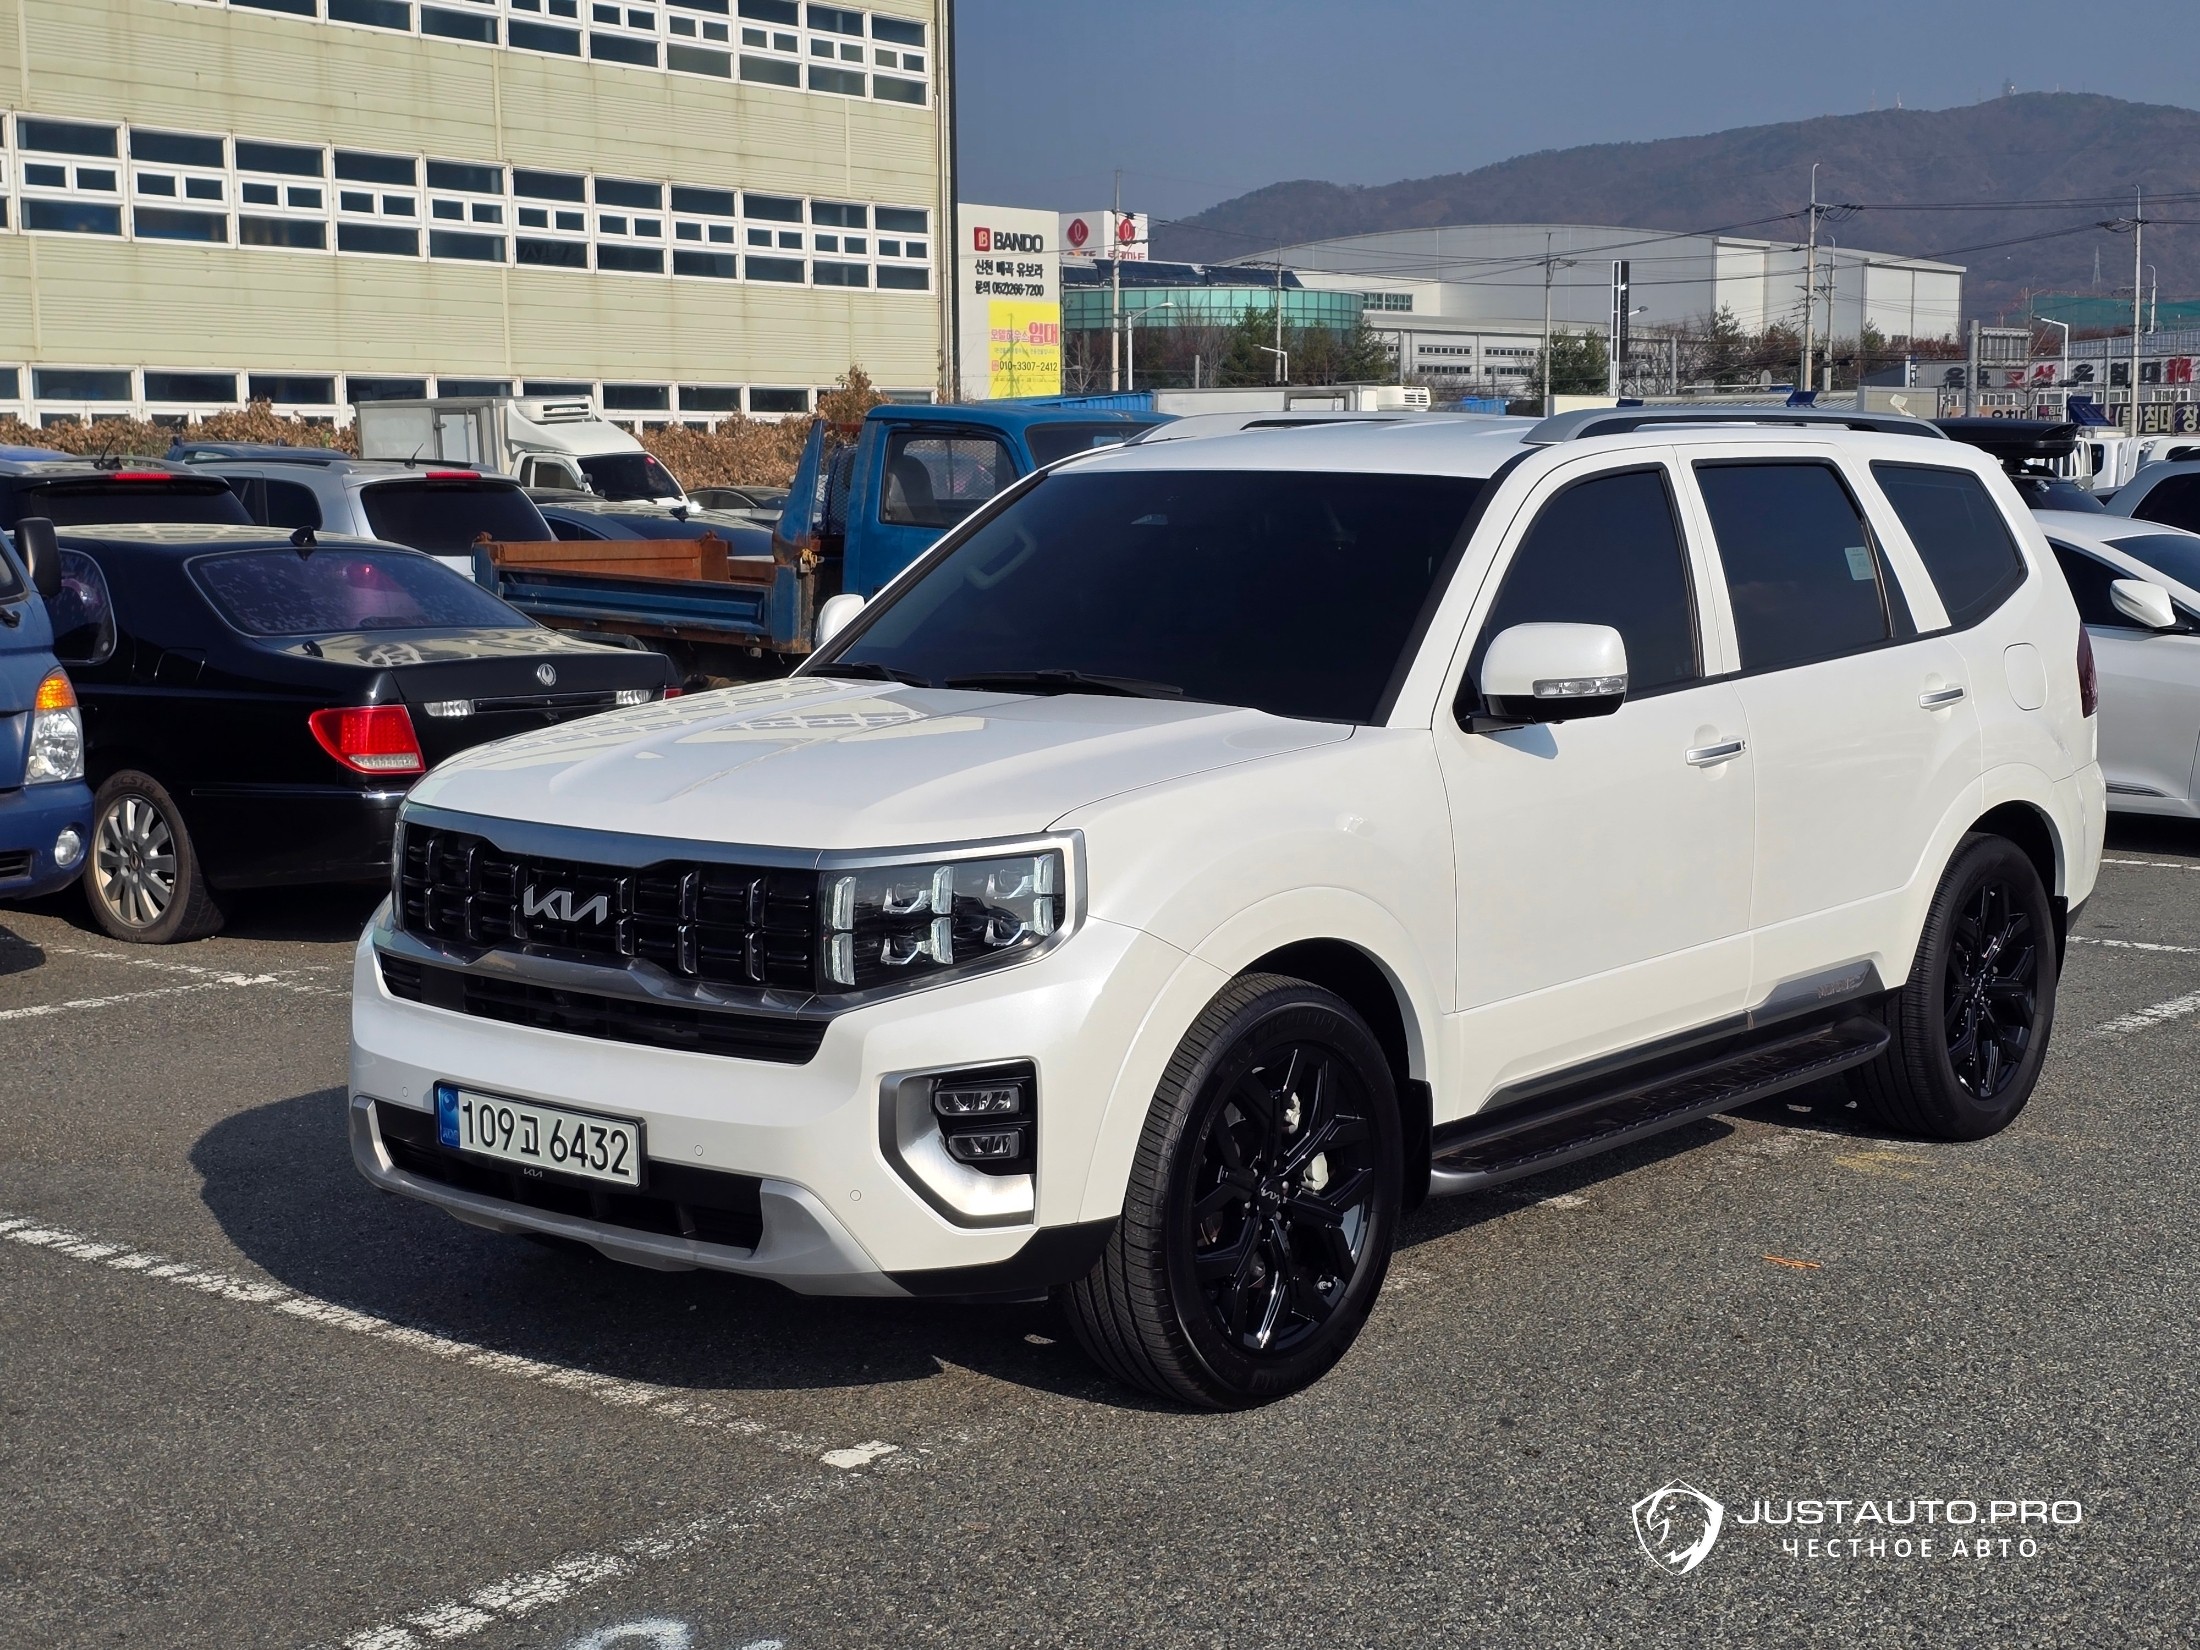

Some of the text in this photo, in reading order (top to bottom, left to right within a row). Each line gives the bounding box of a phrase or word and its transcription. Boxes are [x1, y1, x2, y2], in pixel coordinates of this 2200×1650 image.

[993, 231, 1044, 253] BANDO
[1028, 322, 1059, 345] 임대
[999, 361, 1059, 372] 010-3307-2412
[462, 1100, 630, 1176] 109고 6432
